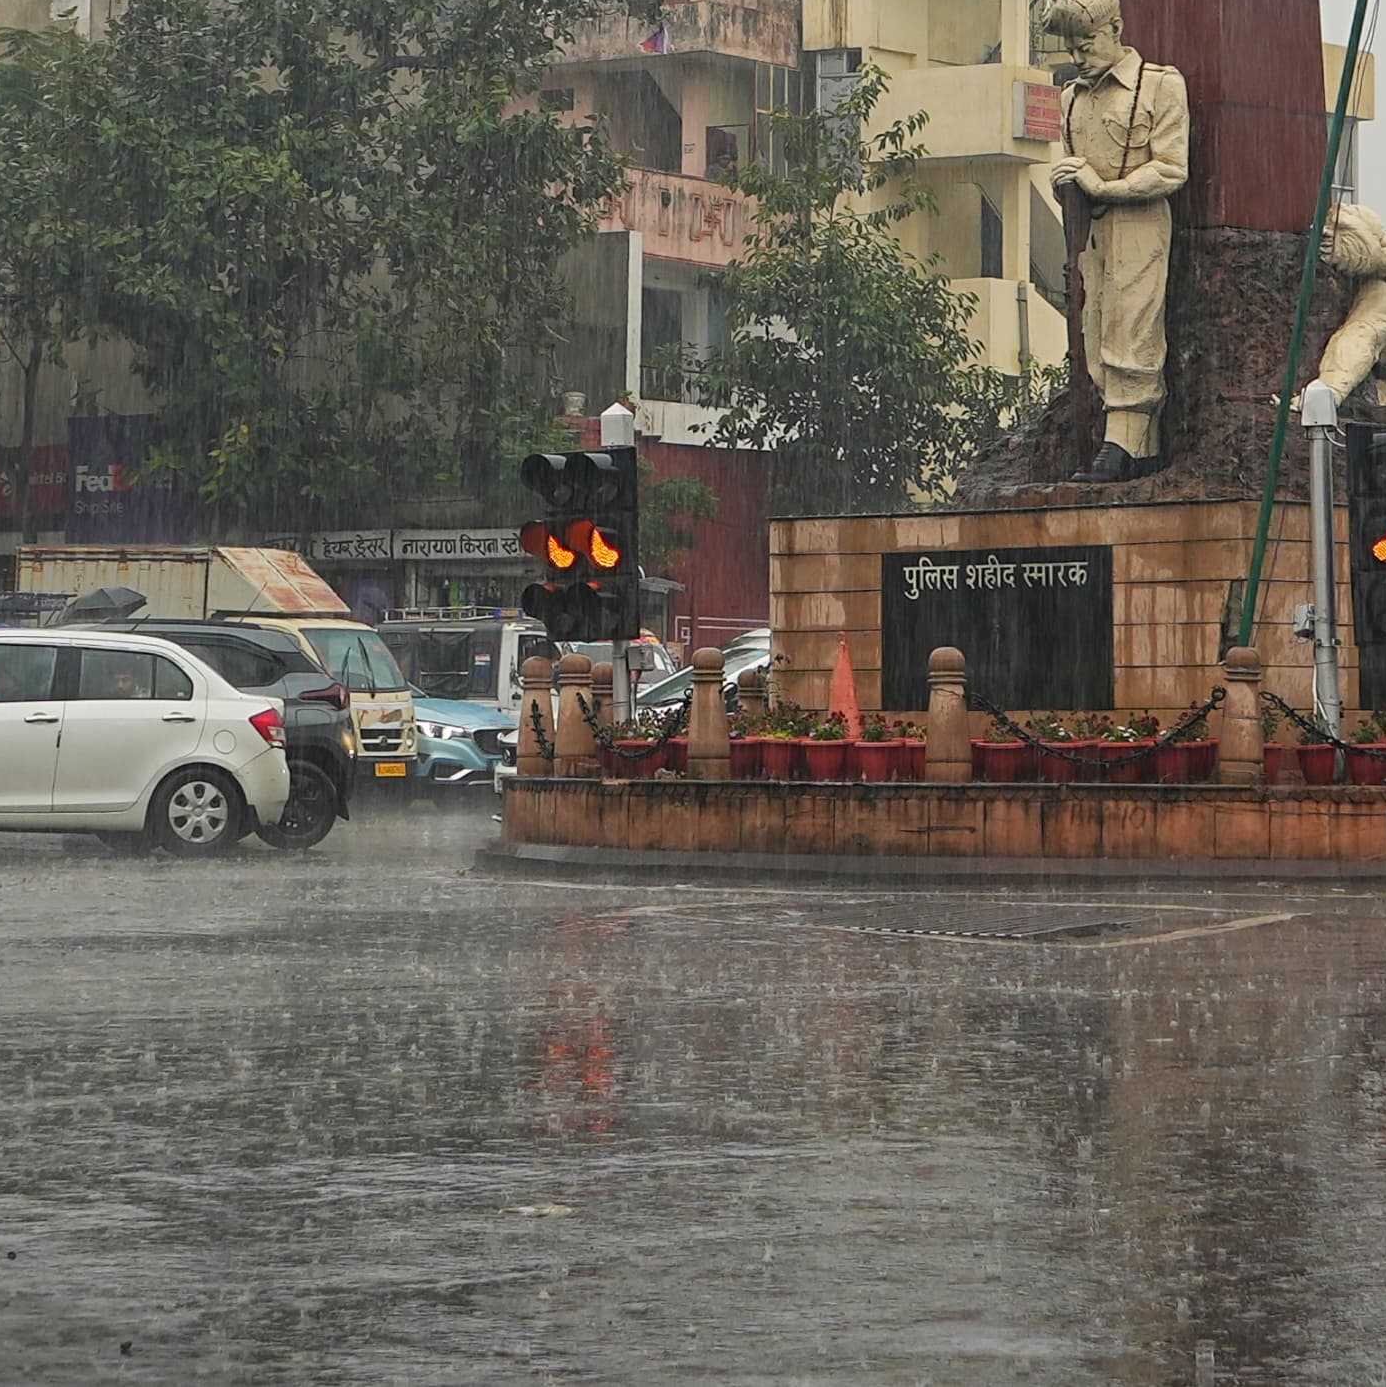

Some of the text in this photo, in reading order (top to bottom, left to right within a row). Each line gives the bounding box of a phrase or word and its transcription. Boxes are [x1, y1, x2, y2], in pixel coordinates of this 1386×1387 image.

[322, 538, 353, 559] हेयर
[401, 538, 456, 558] नारायण
[500, 532, 521, 556] स्टो
[903, 555, 1088, 599] पुलिस शहीद स्मारक
